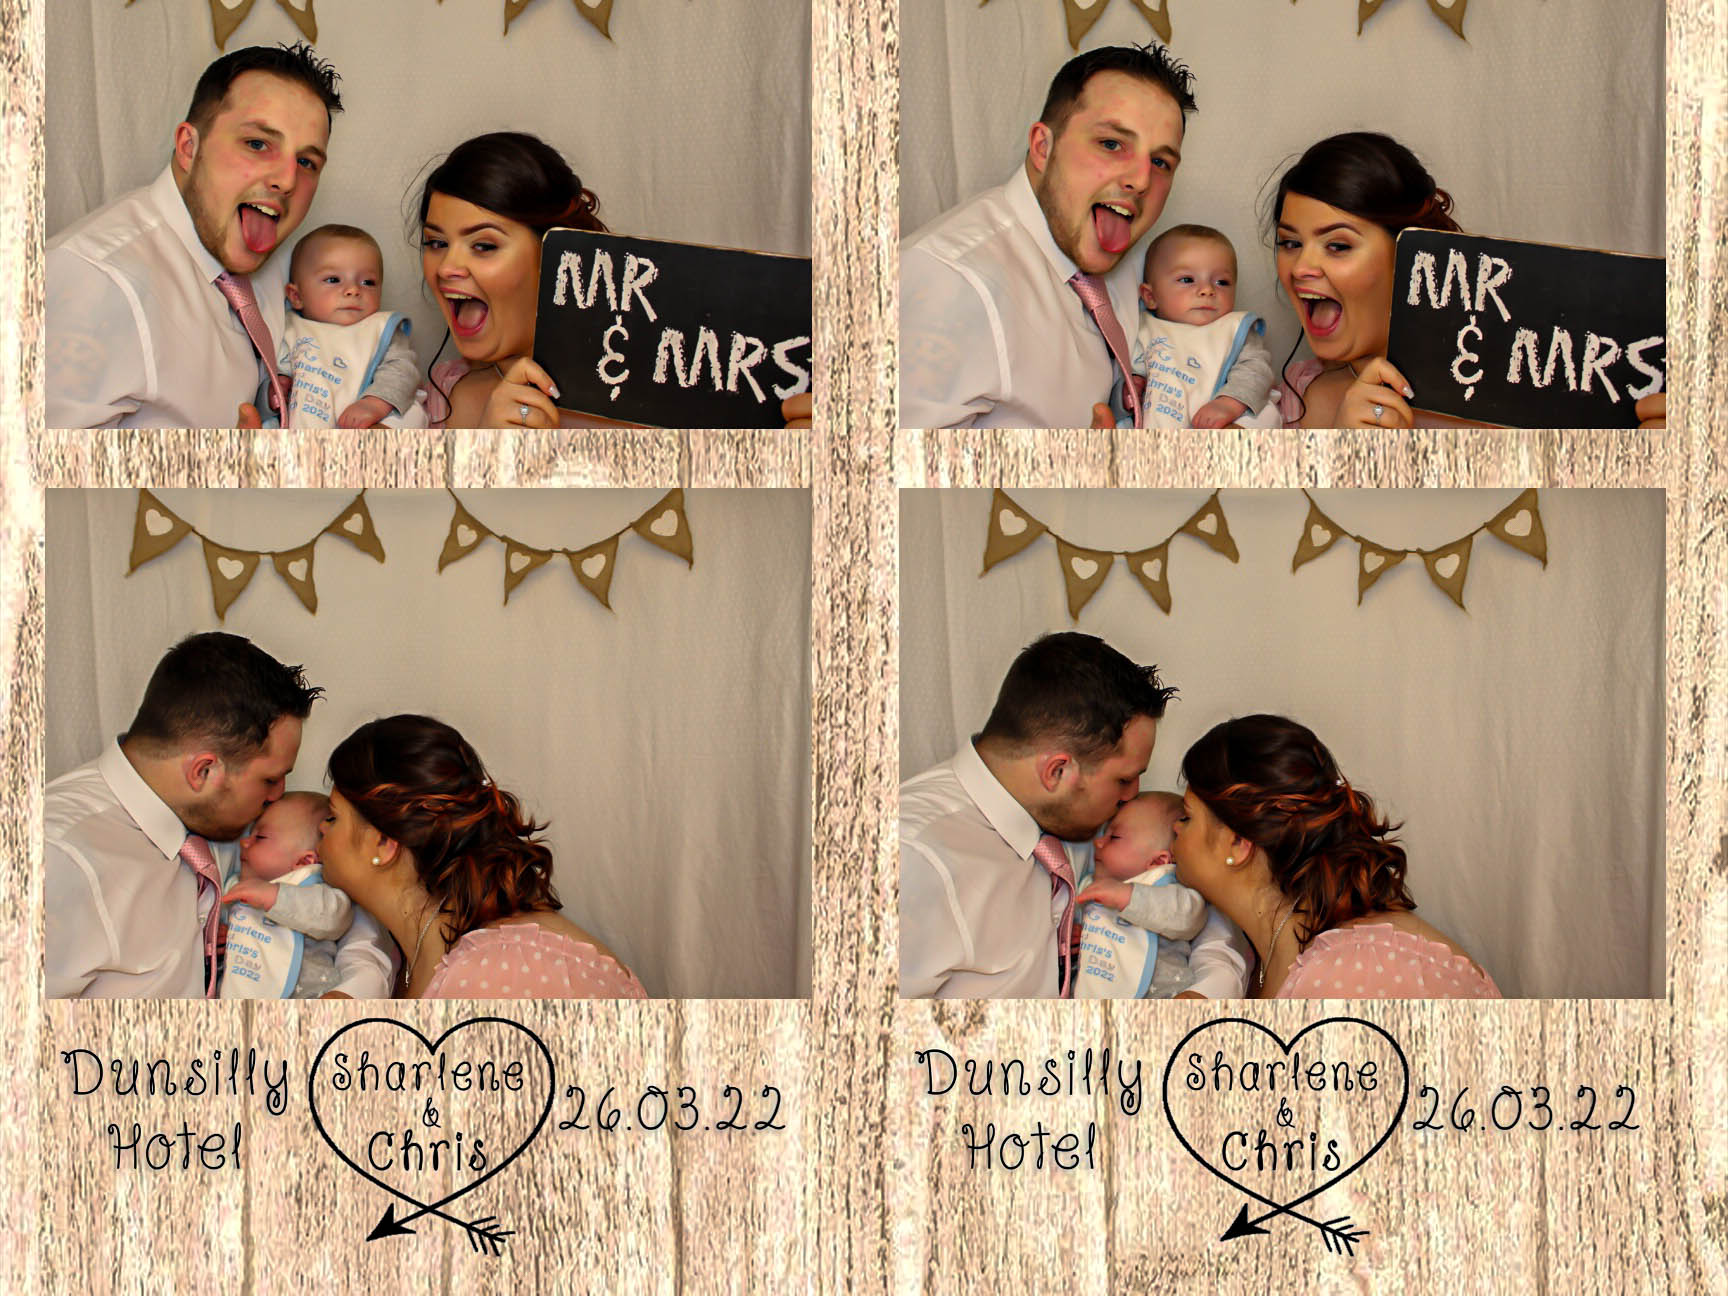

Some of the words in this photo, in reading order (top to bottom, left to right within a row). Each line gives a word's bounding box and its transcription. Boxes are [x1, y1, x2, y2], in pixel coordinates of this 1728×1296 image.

[553, 248, 659, 323] MR
[1407, 248, 1513, 323] MR
[652, 325, 811, 404] MRS
[1506, 325, 1665, 404] MRS
[302, 404, 329, 422] 2022
[1156, 404, 1183, 422] 2022
[232, 966, 260, 981] 2022
[1086, 966, 1114, 981] 2022
